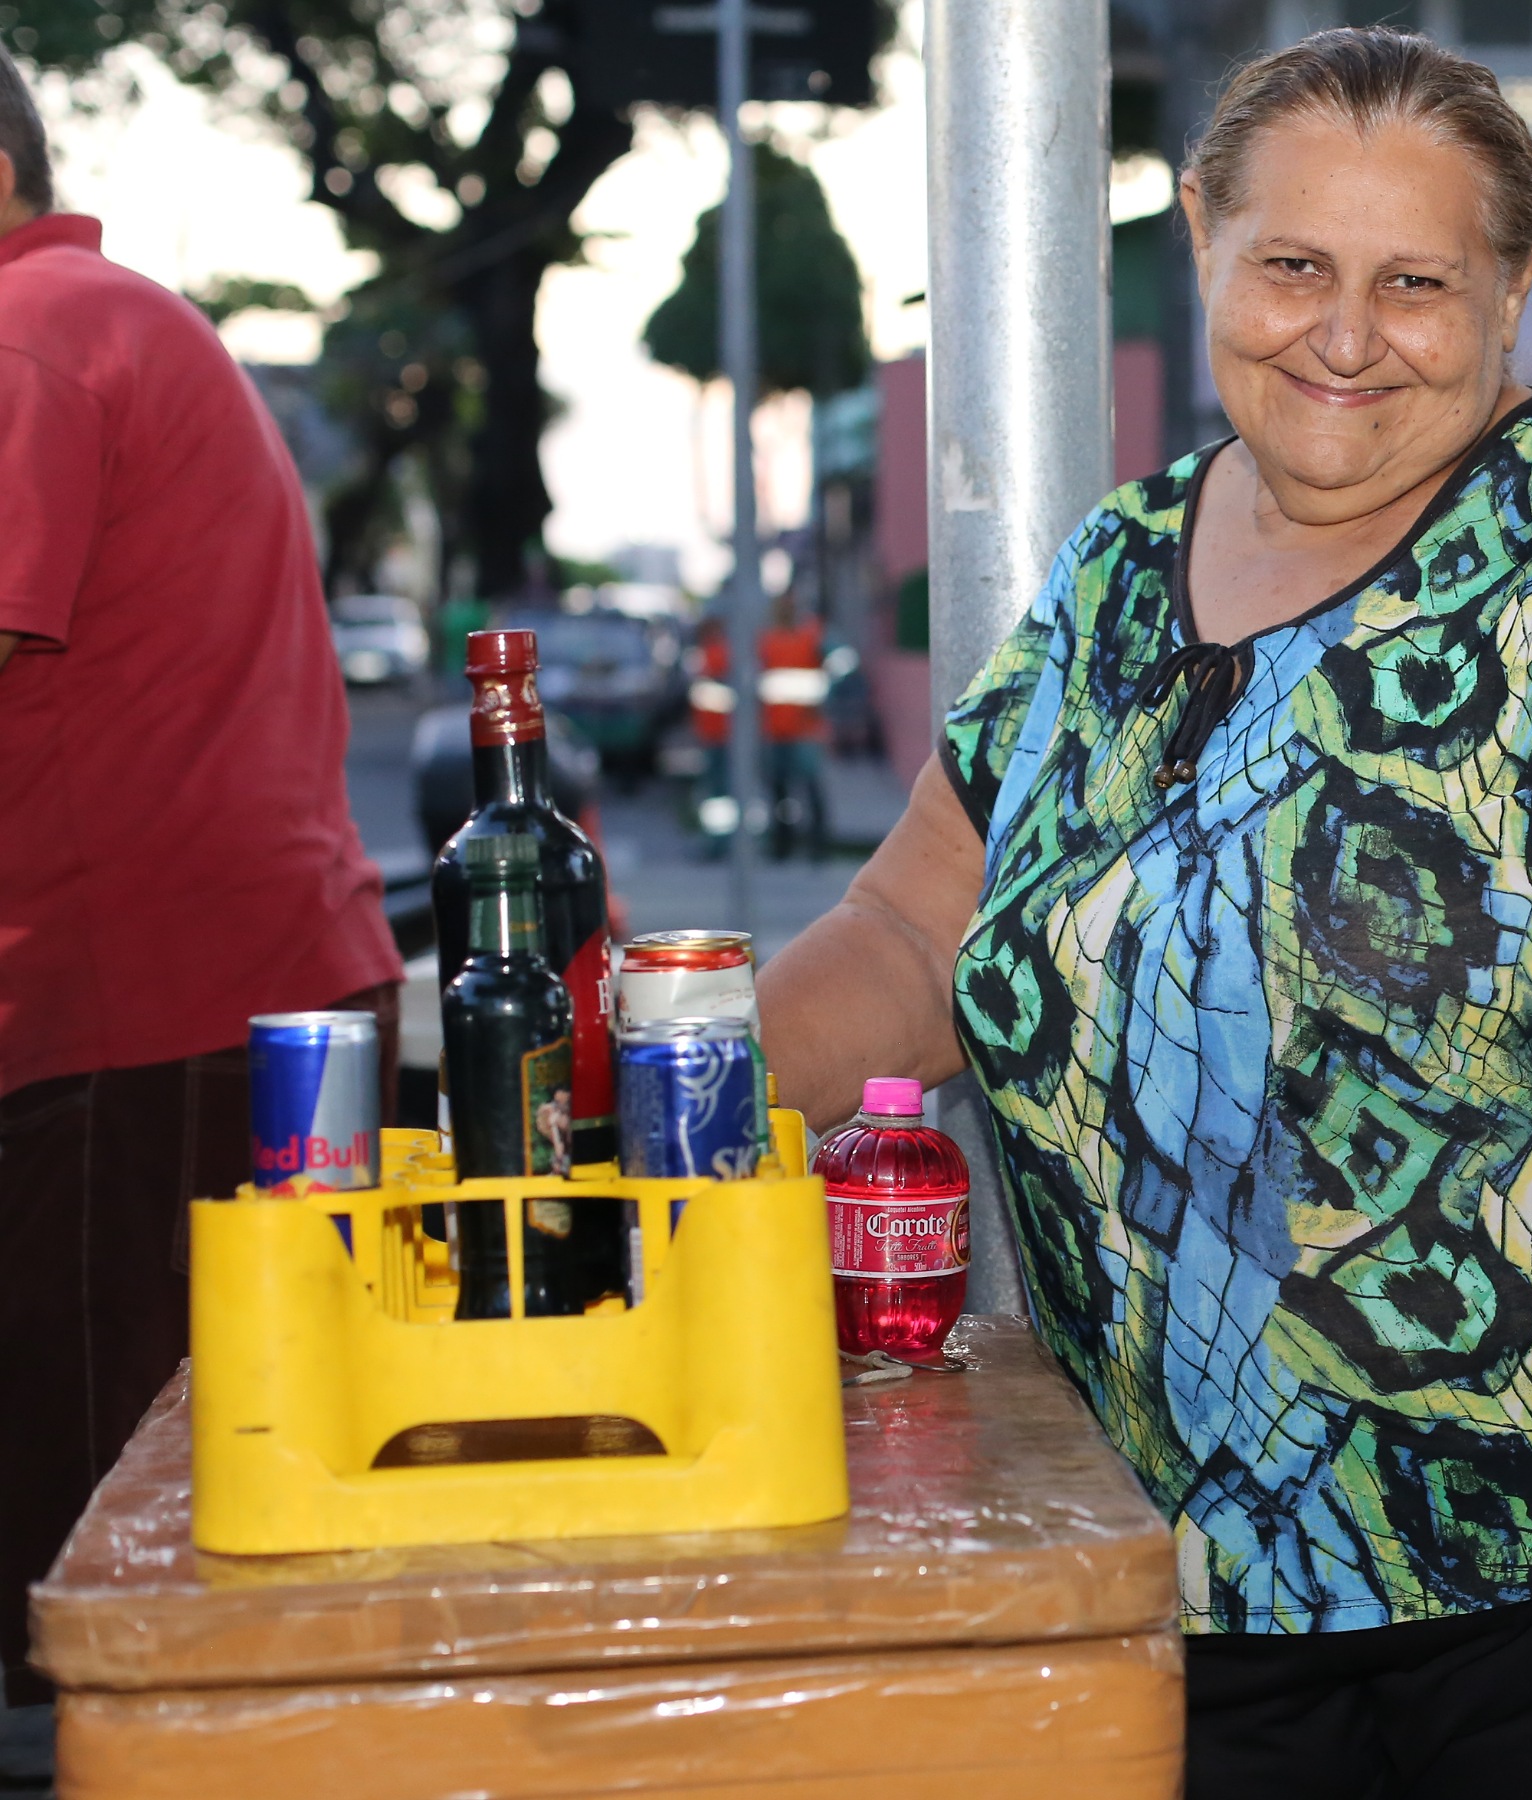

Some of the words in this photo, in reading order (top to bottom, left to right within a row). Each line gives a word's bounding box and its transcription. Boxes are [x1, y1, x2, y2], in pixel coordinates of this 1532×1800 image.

[304, 1131, 369, 1170] Bull
[866, 1212, 946, 1238] Corote
[897, 1253, 919, 1261] SABORES
